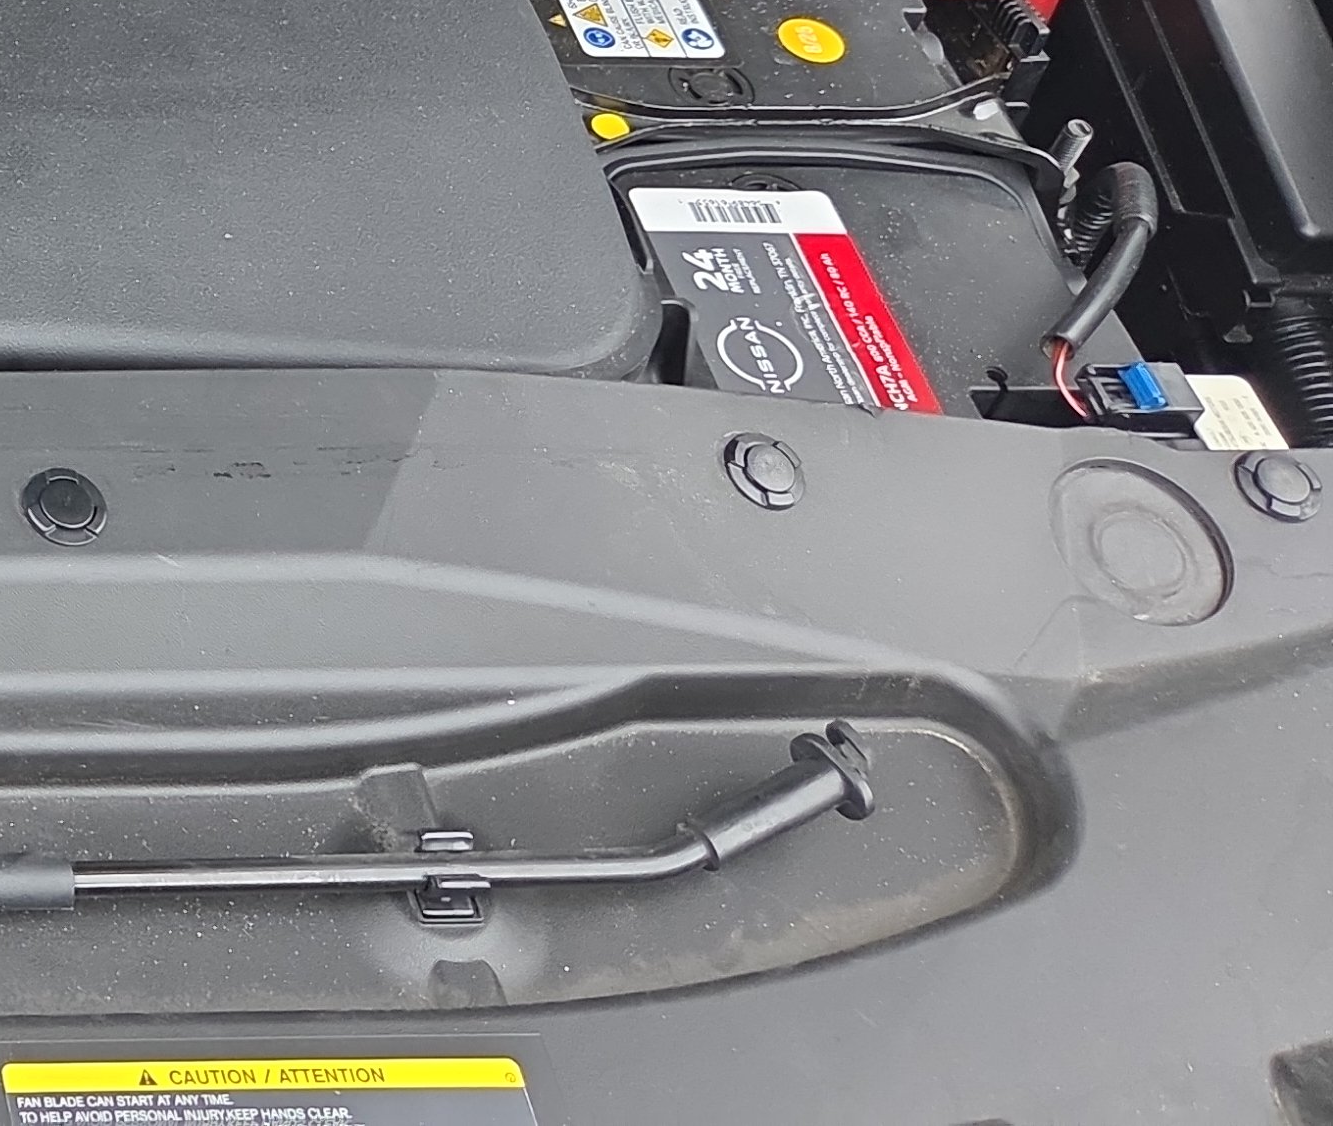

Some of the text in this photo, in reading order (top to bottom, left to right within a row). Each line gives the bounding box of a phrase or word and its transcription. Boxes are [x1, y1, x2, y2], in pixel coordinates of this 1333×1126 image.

[682, 249, 729, 290] 24
[710, 248, 744, 293] MONTH
[776, 267, 789, 279] TN
[844, 300, 858, 318] 140
[736, 317, 785, 393] NISSAN
[826, 364, 845, 389] North
[169, 1068, 385, 1084] CAUTION / ATTENTION
[17, 1097, 41, 1108] FAN
[44, 1096, 85, 1107] BLADE
[86, 1096, 114, 1106] CAN
[116, 1095, 154, 1106] START
[157, 1095, 171, 1105] AT
[174, 1095, 199, 1105] ANY
[19, 1112, 37, 1123] TO
[40, 1111, 72, 1123] HELP
[75, 1111, 113, 1122] AVOID
[115, 1110, 182, 1121] PERSONAL
[261, 1108, 305, 1120] HANDS
